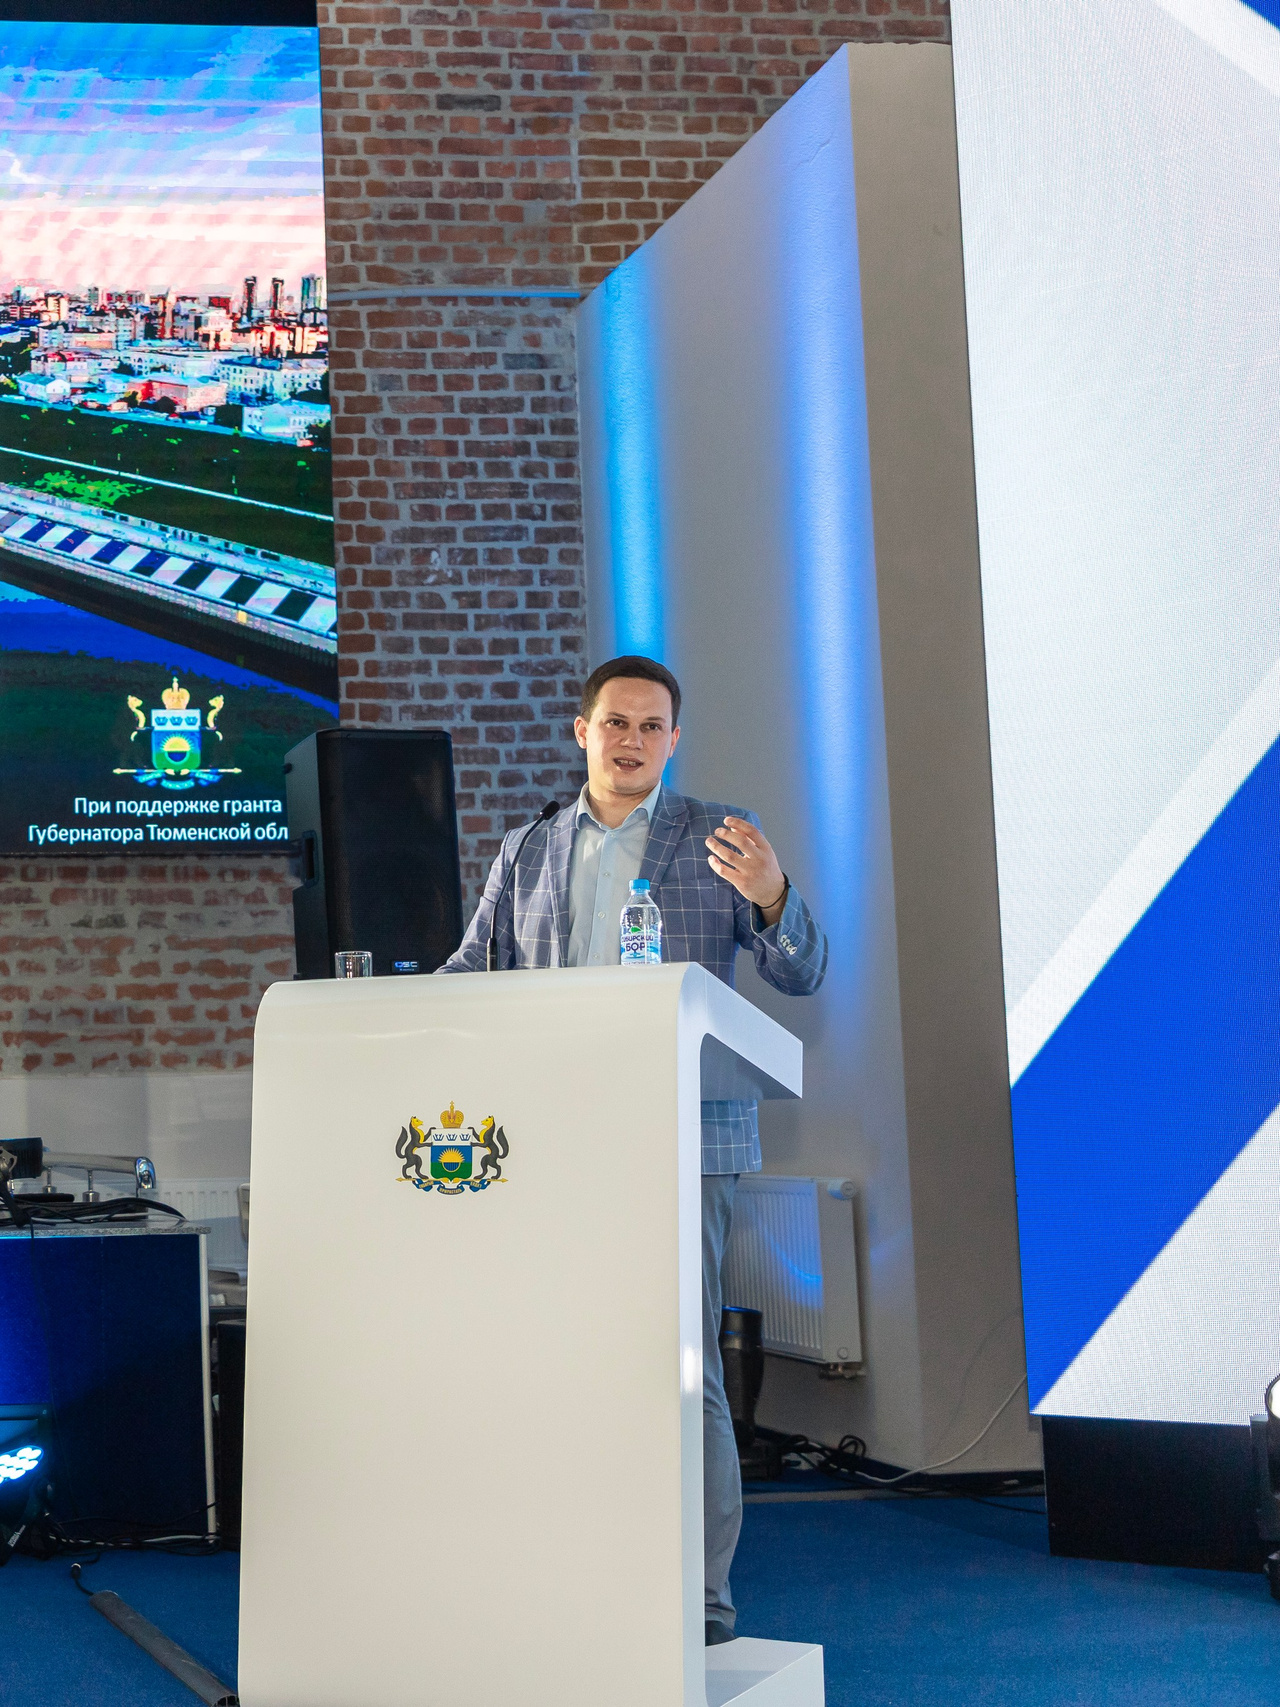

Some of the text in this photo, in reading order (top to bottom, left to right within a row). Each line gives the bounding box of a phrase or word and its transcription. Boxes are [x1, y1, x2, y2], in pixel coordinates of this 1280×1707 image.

[74, 797, 282, 817] При поддержке гранта
[28, 822, 289, 846] Губернатора Тюменской обл
